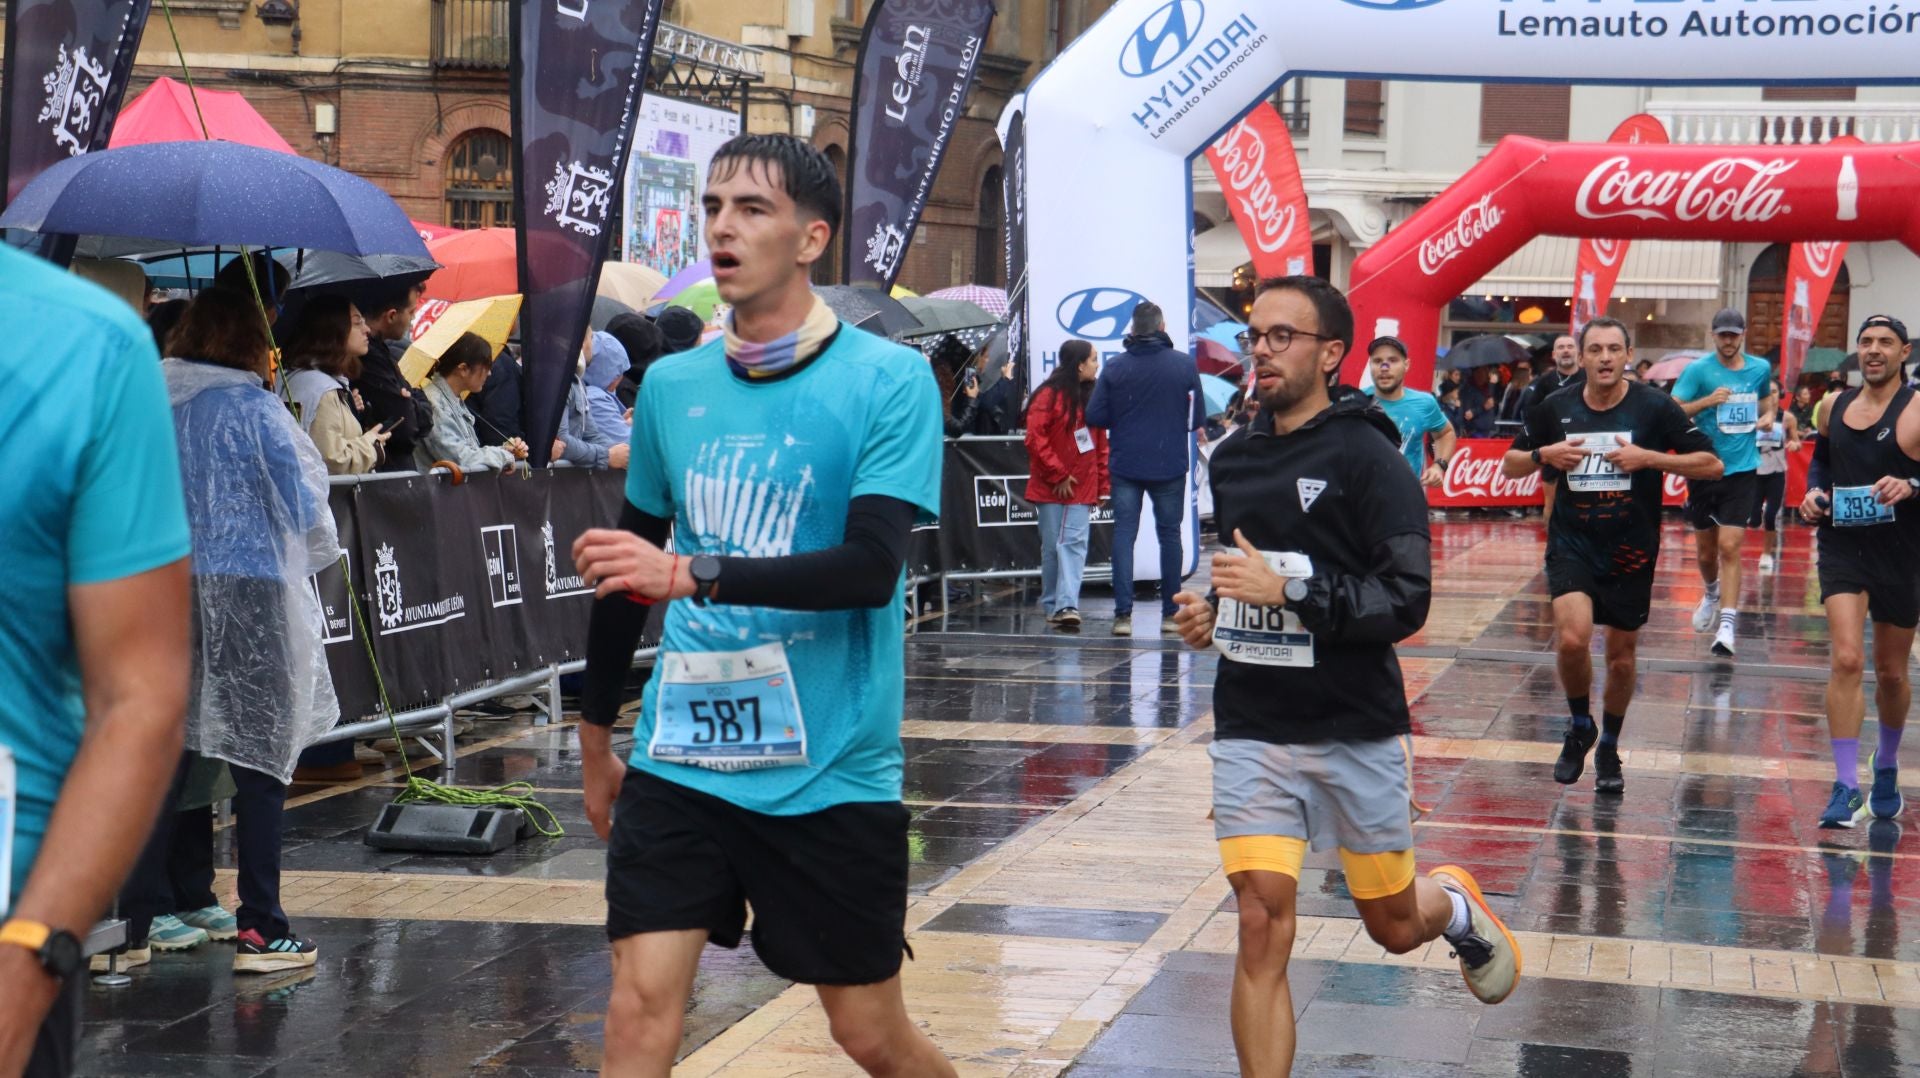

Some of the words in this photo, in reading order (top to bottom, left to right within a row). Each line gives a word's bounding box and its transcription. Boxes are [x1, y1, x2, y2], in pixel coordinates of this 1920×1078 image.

[1498, 9, 1668, 37] Lemauto
[1680, 4, 1920, 37] Automoción
[949, 83, 962, 104] DE
[957, 35, 977, 78] LEÓN
[1131, 13, 1258, 130] HYUNDAI
[1150, 96, 1200, 140] Lemauto
[1200, 33, 1268, 97] Automoción
[1575, 156, 1798, 222] Coca-Cola
[1418, 191, 1500, 276] Coca-Cola
[1729, 407, 1748, 421] 451
[980, 491, 1006, 507] LEÓN
[1844, 495, 1877, 518] 393
[507, 572, 514, 580] ES
[326, 606, 334, 615] ES
[1245, 645, 1293, 657] HYUNDAI
[706, 686, 731, 696] POZO
[688, 696, 762, 744] 587
